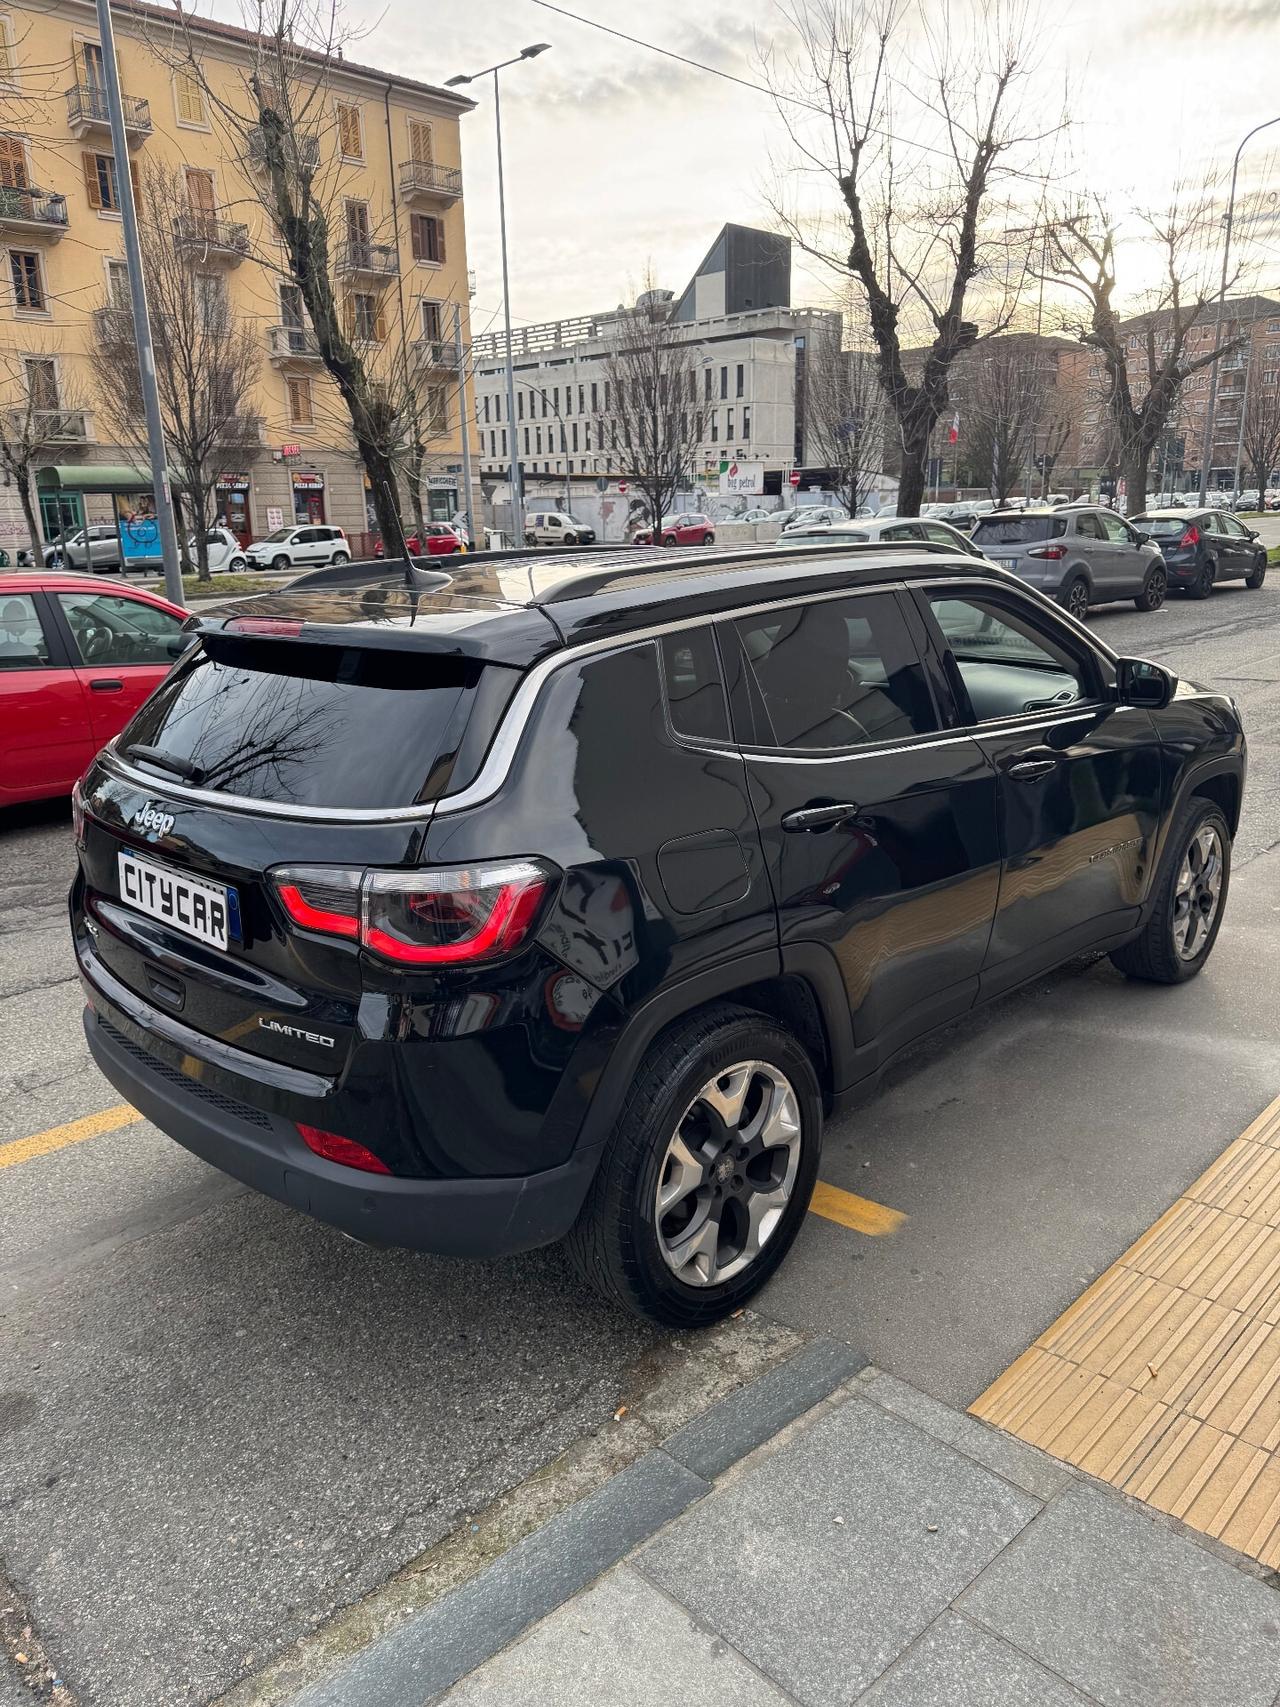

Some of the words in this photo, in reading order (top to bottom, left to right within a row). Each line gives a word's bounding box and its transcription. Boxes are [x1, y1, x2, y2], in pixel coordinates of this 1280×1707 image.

[135, 801, 175, 838] Jeep
[124, 863, 226, 942] CITYCAR
[258, 1017, 335, 1048] LIMITED
